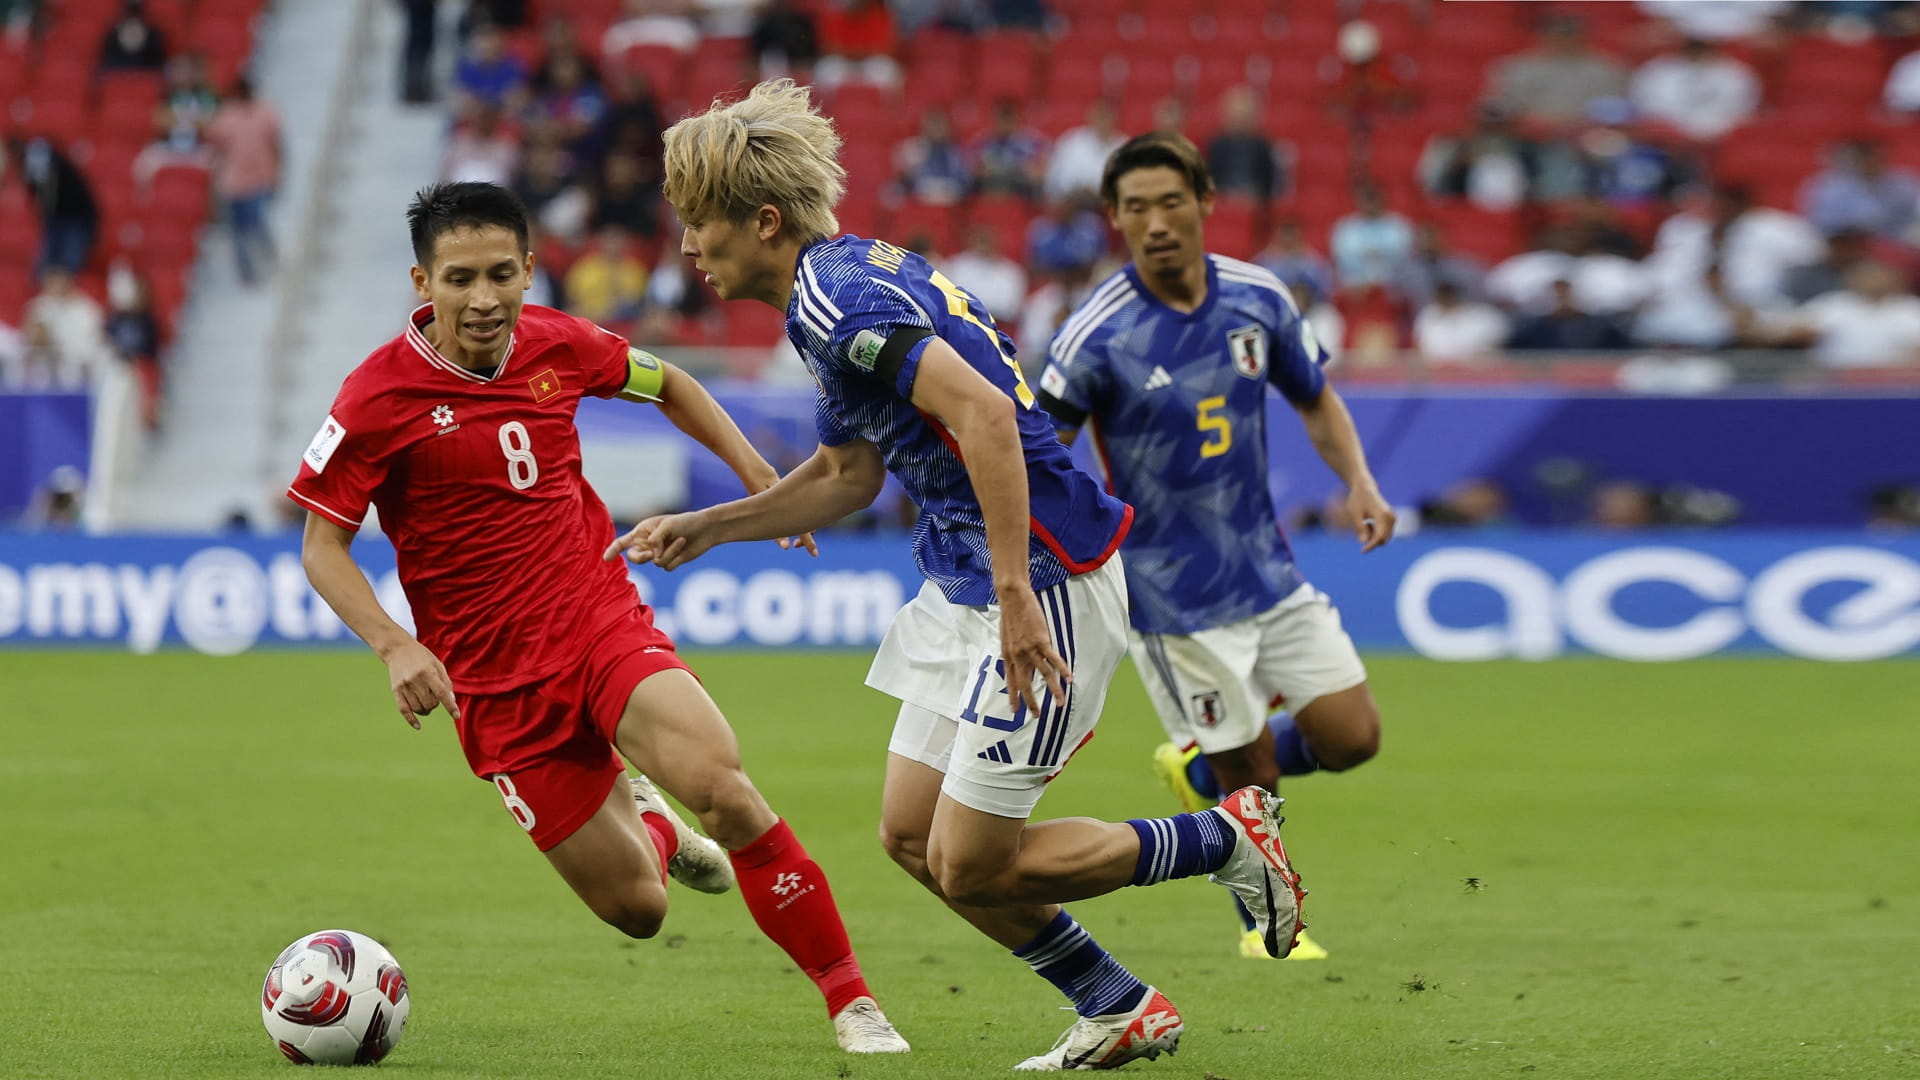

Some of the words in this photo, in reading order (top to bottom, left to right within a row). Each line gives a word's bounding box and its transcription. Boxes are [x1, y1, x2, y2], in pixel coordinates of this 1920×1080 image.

[861, 339, 880, 366] LIVE
[498, 421, 538, 490] 8
[1196, 396, 1232, 458] 5
[1396, 546, 1920, 662] ace
[960, 655, 1036, 732] 13
[493, 773, 536, 831] 8
